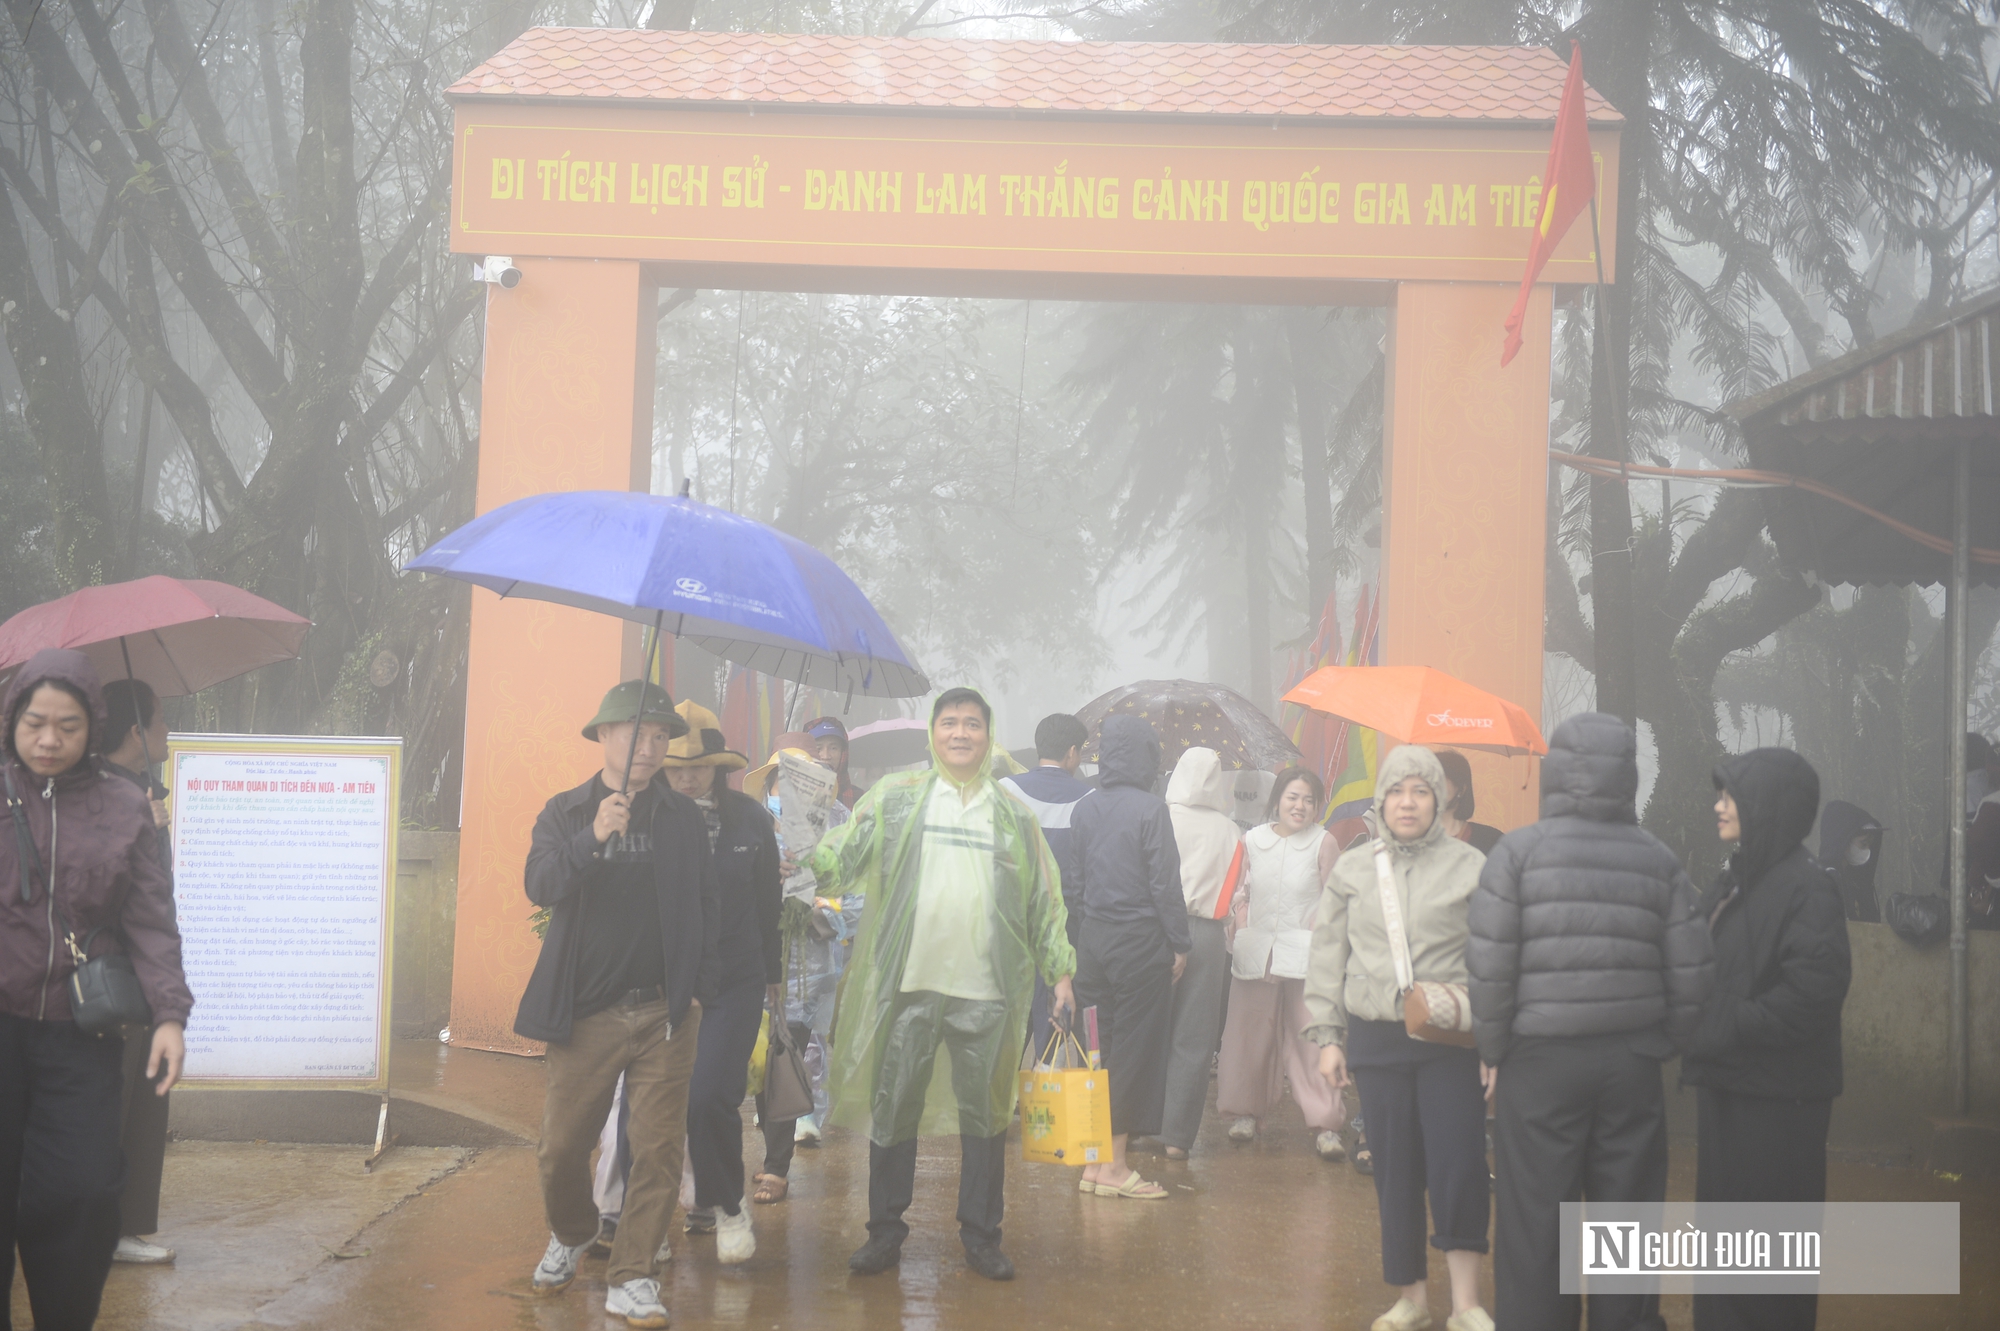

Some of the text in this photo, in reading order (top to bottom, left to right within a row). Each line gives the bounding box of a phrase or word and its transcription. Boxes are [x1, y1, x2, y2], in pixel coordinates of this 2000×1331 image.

[490, 158, 525, 200] DI
[537, 150, 617, 203] TÍCH
[629, 163, 710, 215] LỊCH
[722, 155, 769, 208] SỬ
[804, 168, 903, 213] DANH
[914, 172, 987, 216] LAM
[999, 158, 1120, 220] THẮNG
[1132, 166, 1230, 222] CẢNH
[1242, 165, 1340, 232] QUỐC
[1353, 183, 1412, 226] GIA
[1424, 184, 1477, 227] AM
[1489, 175, 1544, 228] TIÊ
[1426, 709, 1494, 728] FOREVER
[187, 778, 202, 793] NỘI
[203, 780, 219, 792] QUY
[222, 780, 244, 791] THAM
[246, 781, 268, 792] QUAN
[269, 781, 278, 792] DI
[281, 779, 298, 792] TÍCH
[300, 779, 316, 793] ĐỀN
[342, 782, 356, 793] AM
